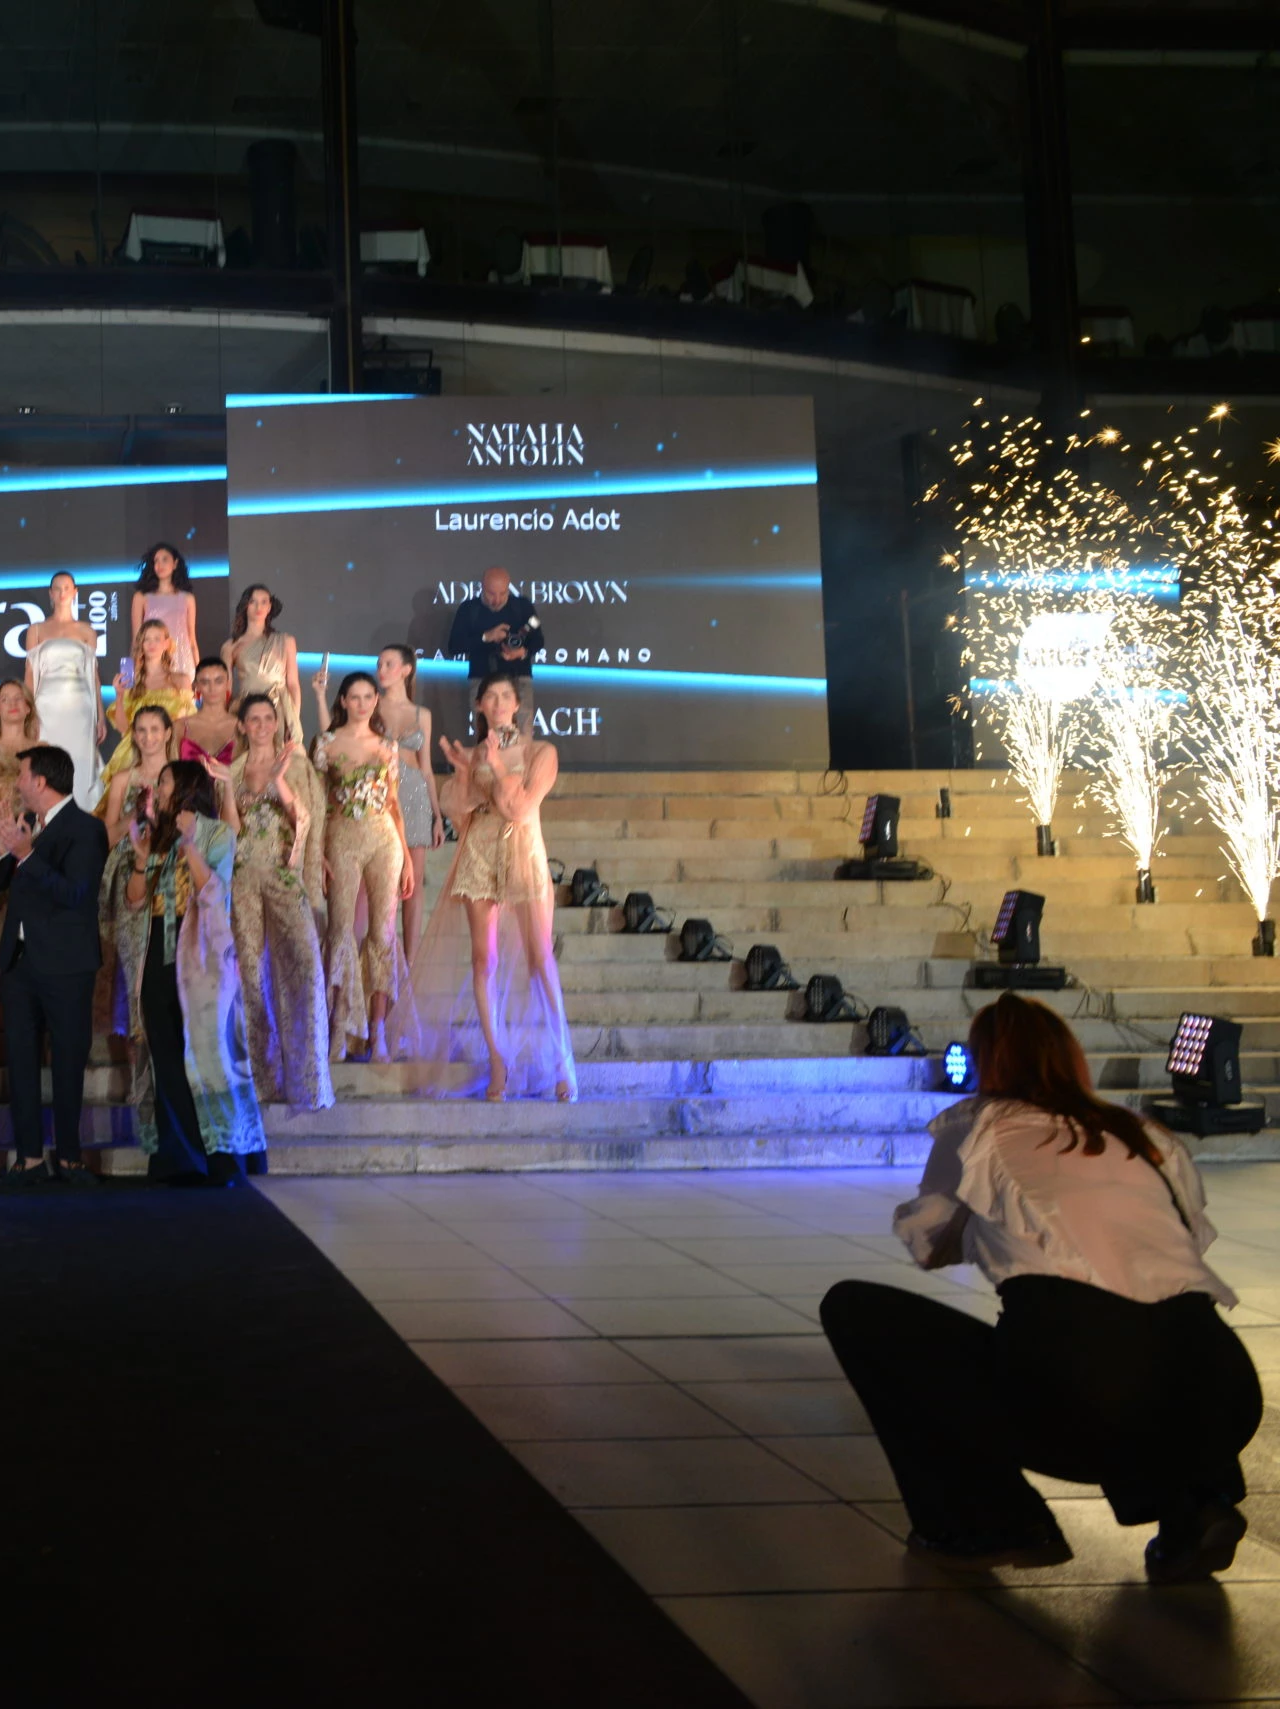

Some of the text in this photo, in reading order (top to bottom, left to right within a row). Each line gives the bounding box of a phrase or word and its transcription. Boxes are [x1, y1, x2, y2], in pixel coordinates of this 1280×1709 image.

[467, 423, 583, 445] NATALIA
[467, 444, 584, 466] ANTOLIN
[435, 508, 620, 531] Laurencio Adot
[433, 581, 628, 604] ADRN BROWN
[535, 647, 652, 664] ROMANO
